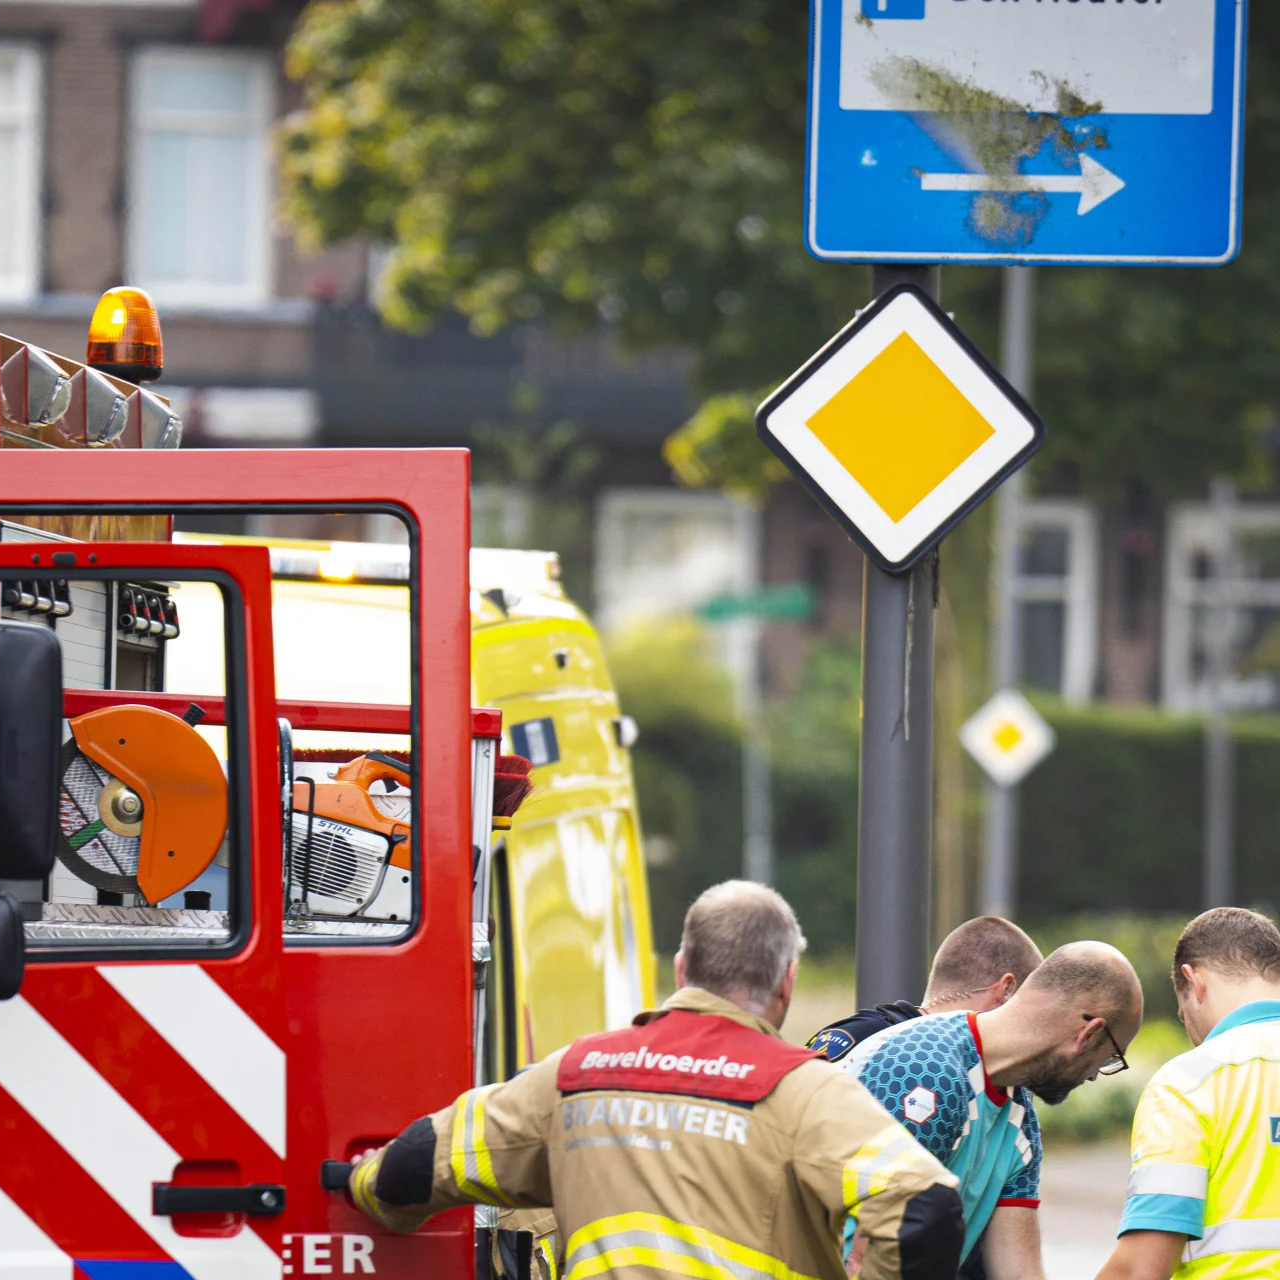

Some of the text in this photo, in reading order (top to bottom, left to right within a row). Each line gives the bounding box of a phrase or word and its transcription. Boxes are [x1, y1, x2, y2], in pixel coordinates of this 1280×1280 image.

[317, 820, 354, 836] STIHL
[580, 1046, 755, 1079] Bevelvoerder
[562, 1097, 750, 1145] BRANDWEER
